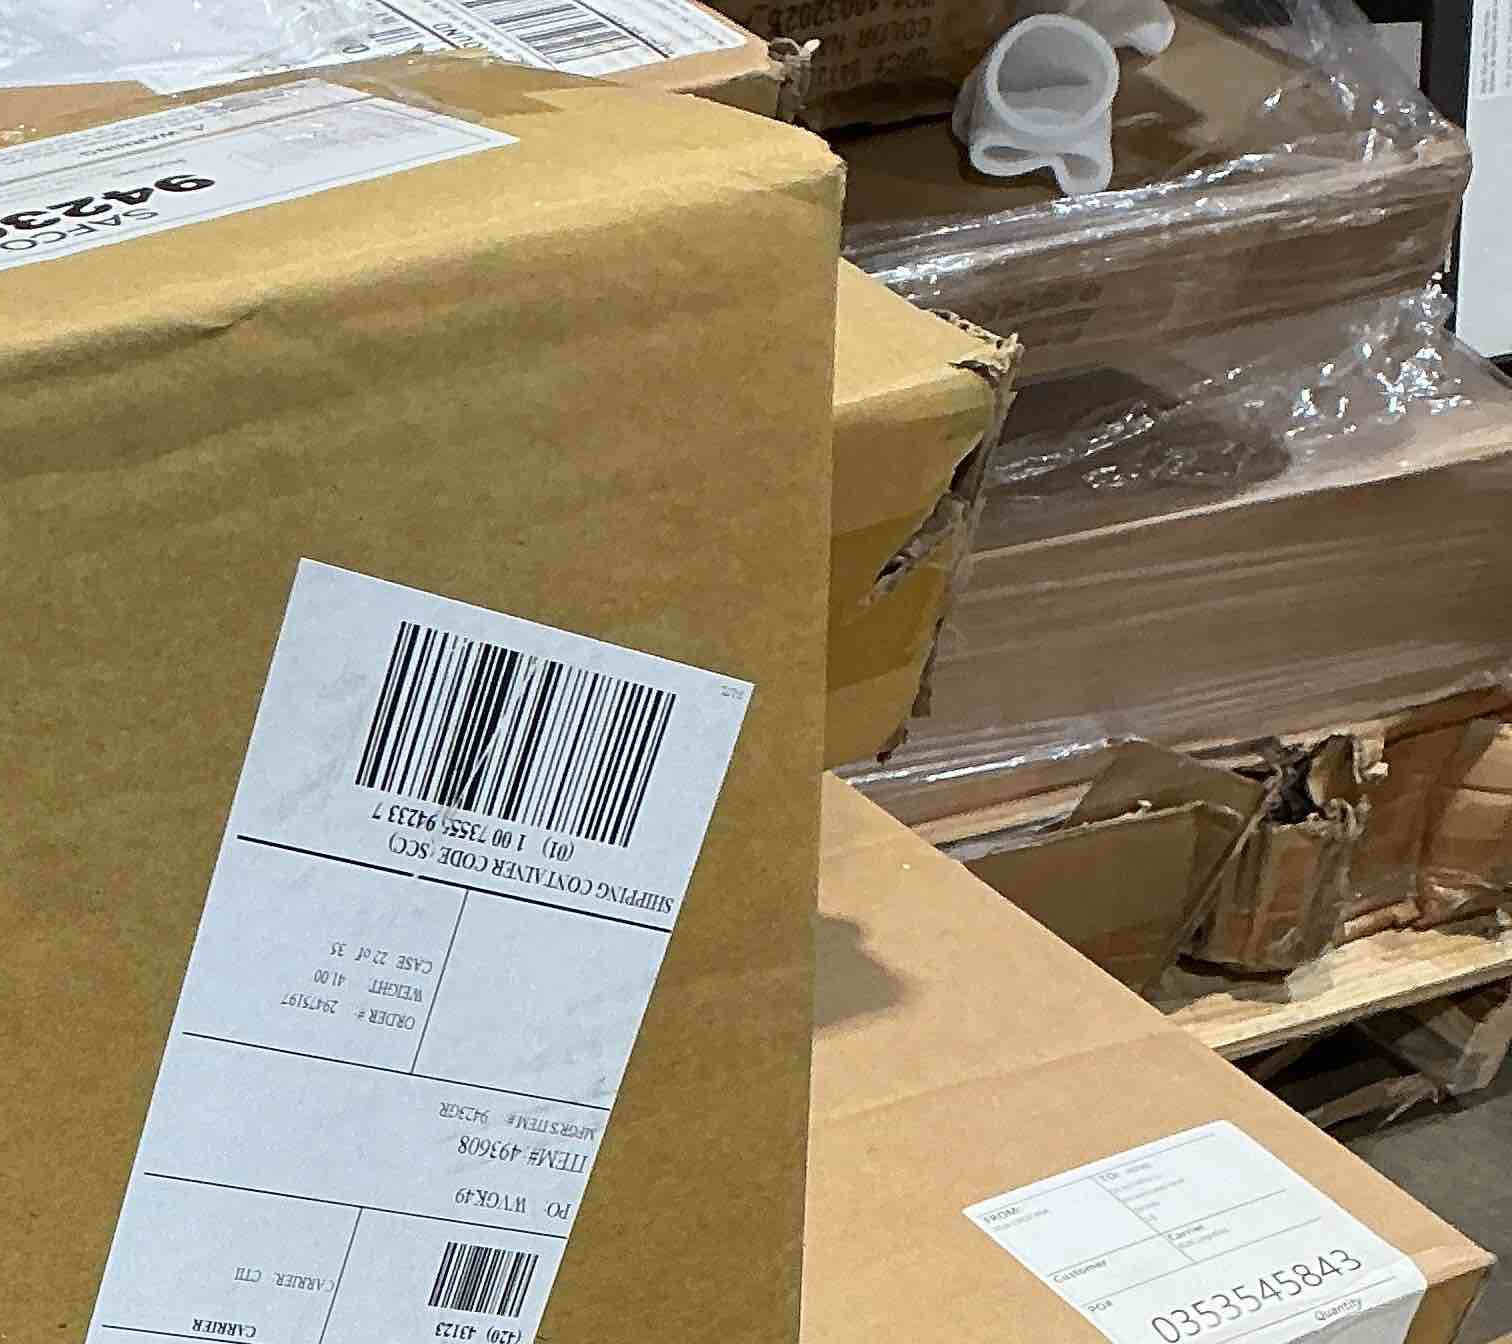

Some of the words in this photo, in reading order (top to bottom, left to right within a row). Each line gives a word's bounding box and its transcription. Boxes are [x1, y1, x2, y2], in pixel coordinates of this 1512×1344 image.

[370, 800, 386, 820] 7
[384, 802, 439, 833] 94233
[489, 827, 514, 848] 00
[514, 833, 527, 851] 1
[539, 835, 576, 863] (01)
[435, 845, 490, 874] CODE
[489, 856, 594, 897] CONTAINER
[593, 879, 675, 915] SHIPPING
[353, 946, 372, 963] of
[394, 954, 433, 975] CASE
[365, 1007, 416, 1031] ORDER
[454, 1133, 525, 1164] 493608
[1053, 1259, 1108, 1283] Customer
[1151, 1249, 1362, 1344] 0353545843
[1314, 1297, 1363, 1322] Quantity
[189, 1317, 258, 1338] CARRIER
[432, 1320, 478, 1341] 43123
